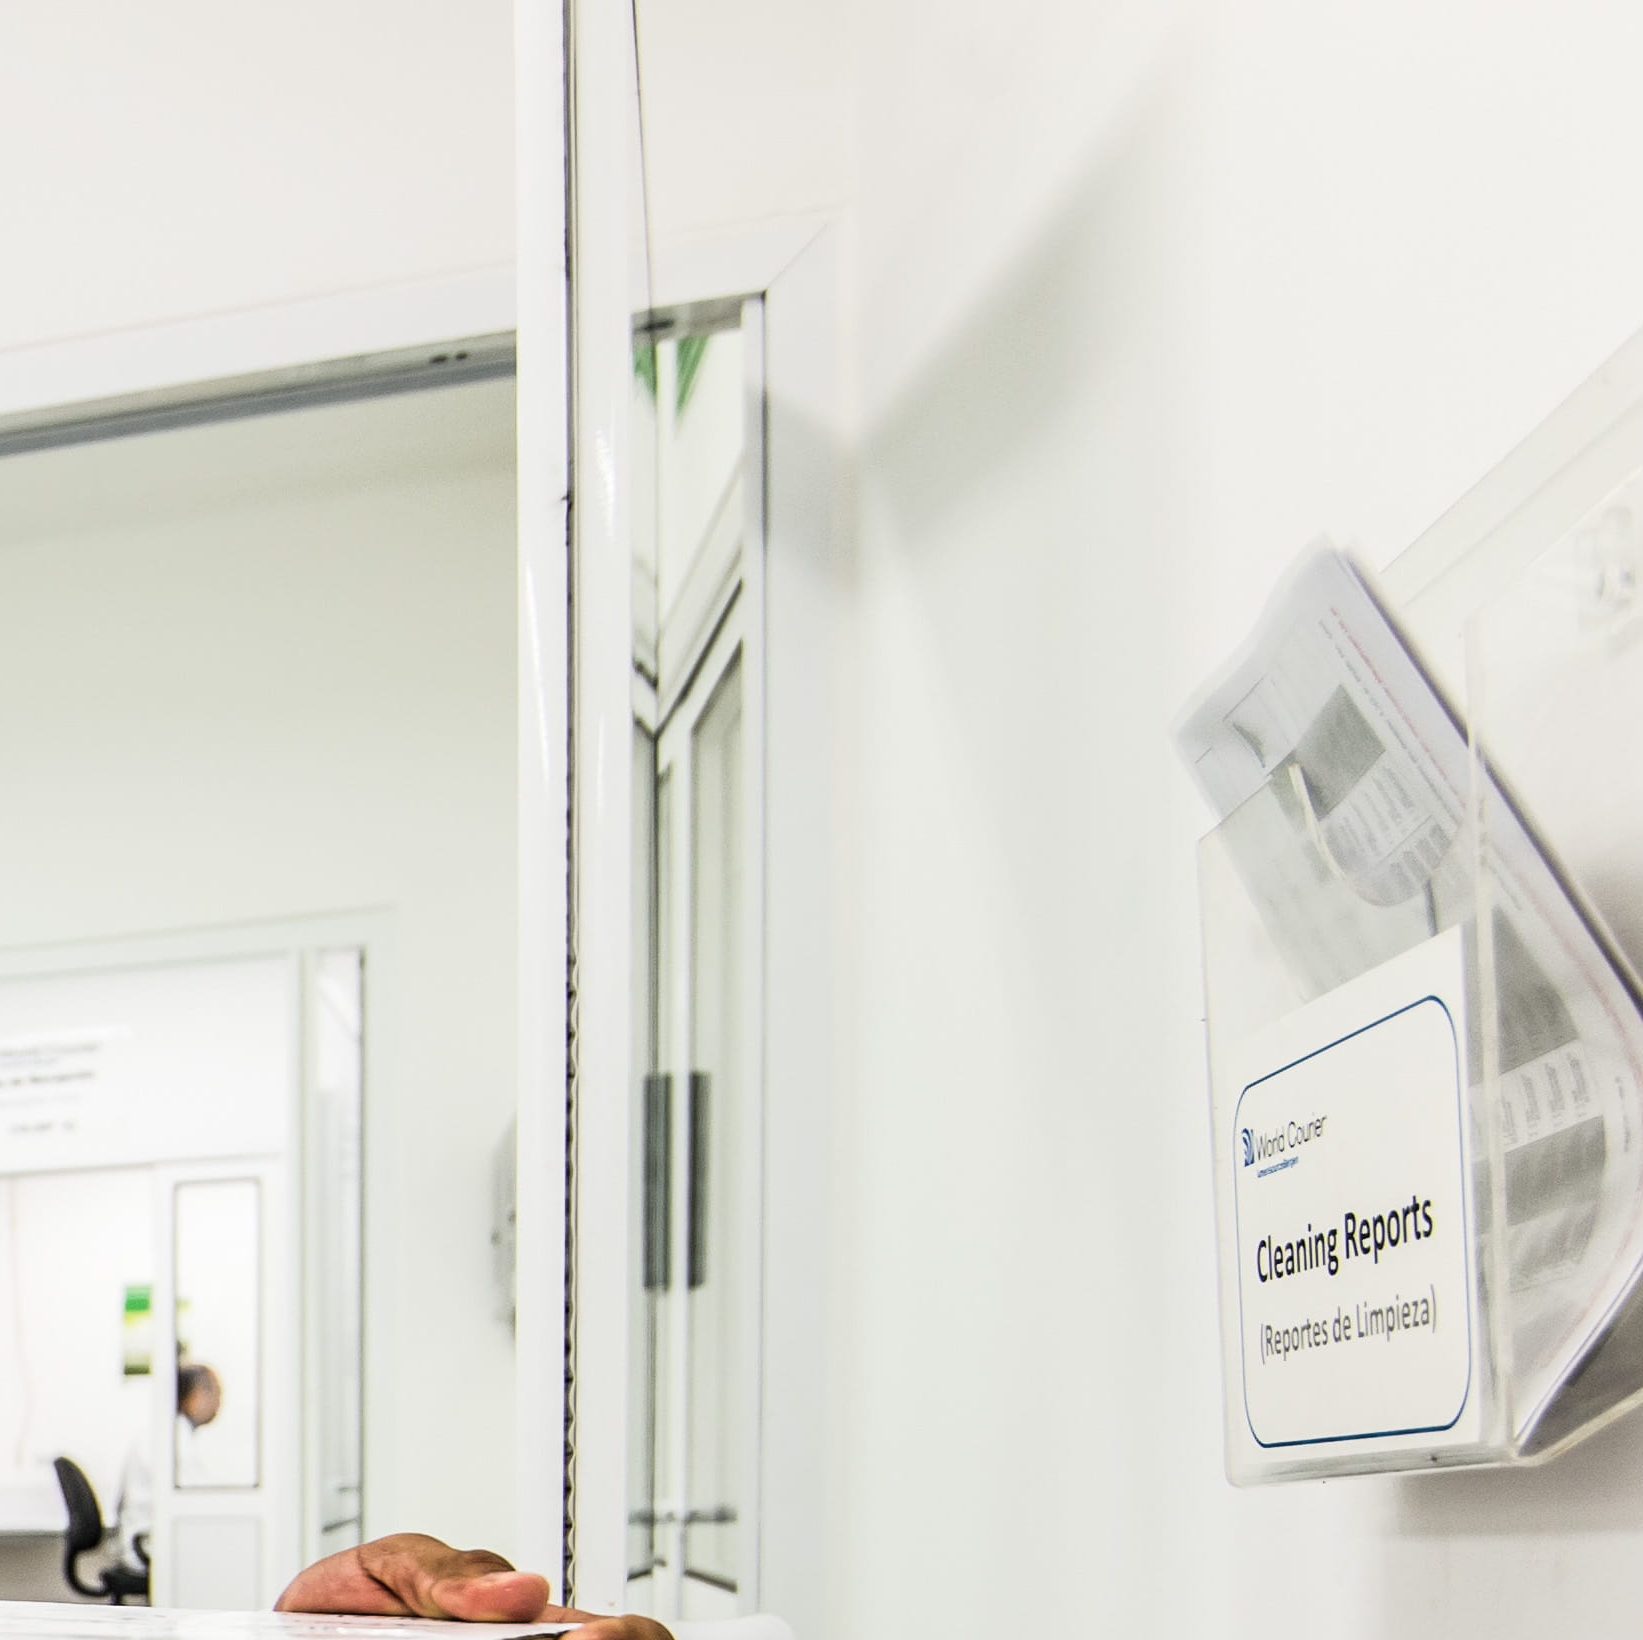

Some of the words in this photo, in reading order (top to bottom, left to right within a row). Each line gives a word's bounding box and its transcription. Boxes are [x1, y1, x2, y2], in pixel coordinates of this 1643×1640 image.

[1256, 1127, 1285, 1161] World
[1287, 1115, 1327, 1149] Courier
[1256, 1223, 1339, 1283] Cleaning
[1344, 1195, 1434, 1264] Reports
[1259, 1317, 1329, 1365] (Reportes
[1331, 1306, 1352, 1344] de
[1356, 1283, 1437, 1343] Limpieza)
